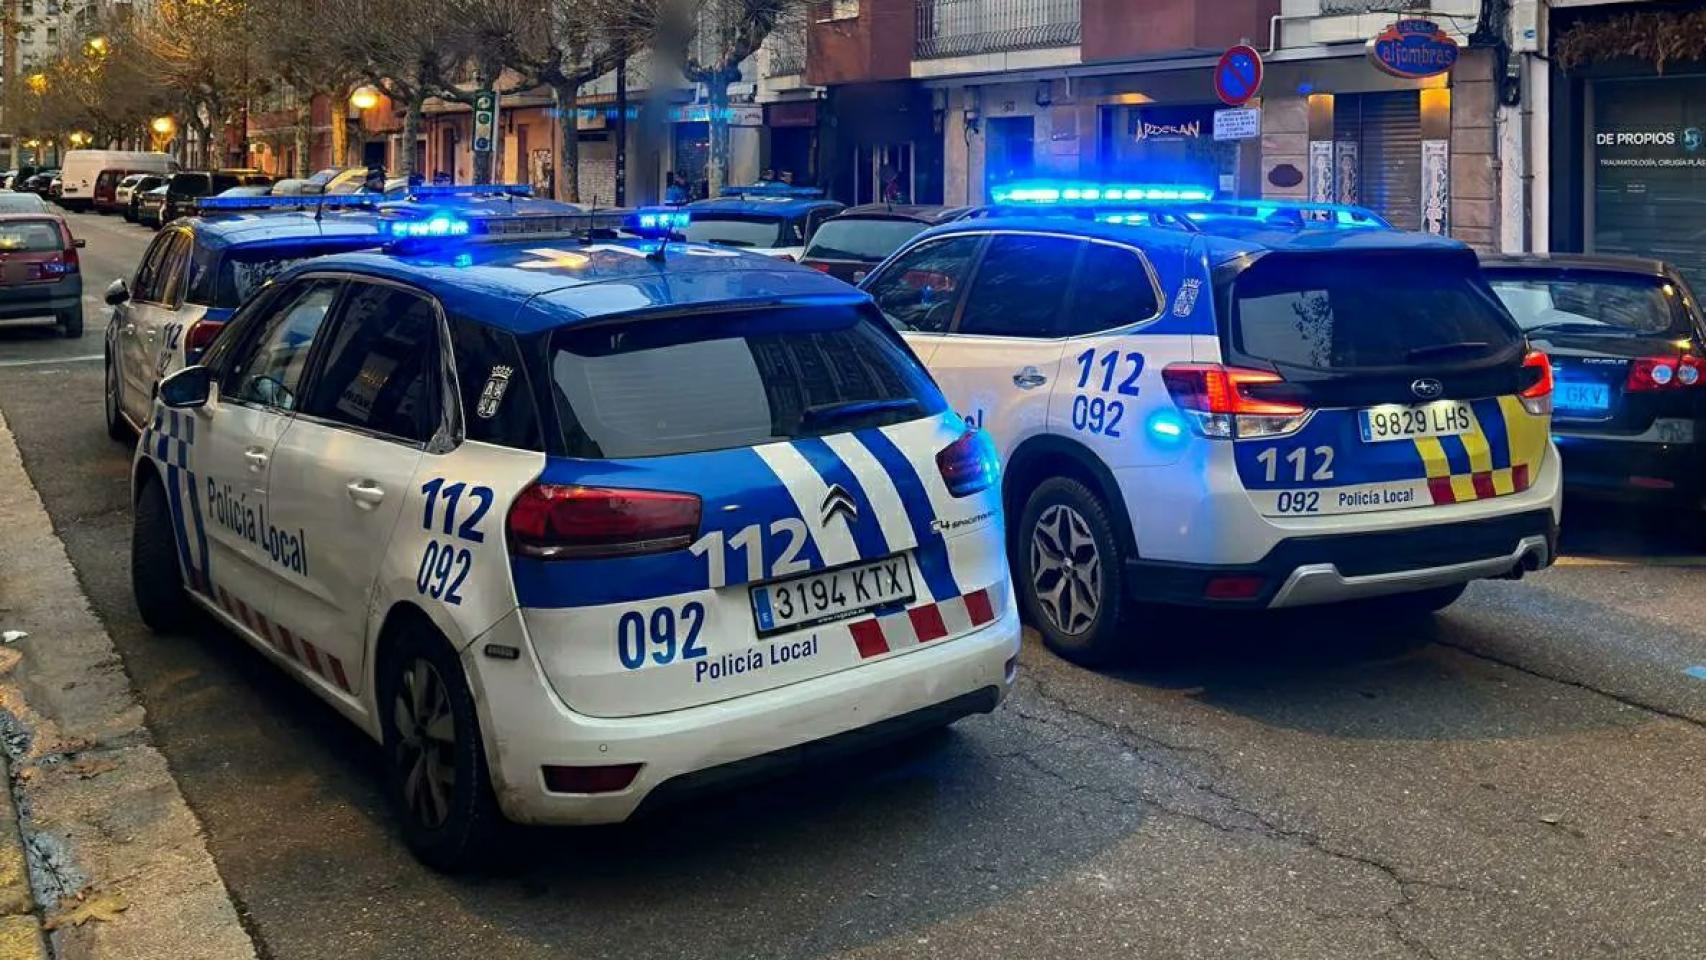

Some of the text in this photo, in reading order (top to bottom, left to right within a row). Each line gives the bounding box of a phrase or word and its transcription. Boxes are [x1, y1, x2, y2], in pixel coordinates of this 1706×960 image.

[1383, 40, 1451, 66] alfombras
[1596, 132, 1675, 145] DE PROPIOS
[1077, 347, 1145, 397] 112
[1072, 394, 1125, 438] 092
[1375, 406, 1469, 436] 9829 LHS
[1256, 446, 1335, 482] 112
[421, 477, 494, 544] 112
[1276, 491, 1320, 513] 092
[1338, 487, 1414, 507] Policía Local
[206, 476, 309, 577] Policía Local
[416, 539, 472, 606] 092
[688, 517, 811, 588] 112
[776, 563, 903, 619] 3194 KTX
[618, 601, 708, 670] 092
[695, 634, 818, 683] Policía Local
